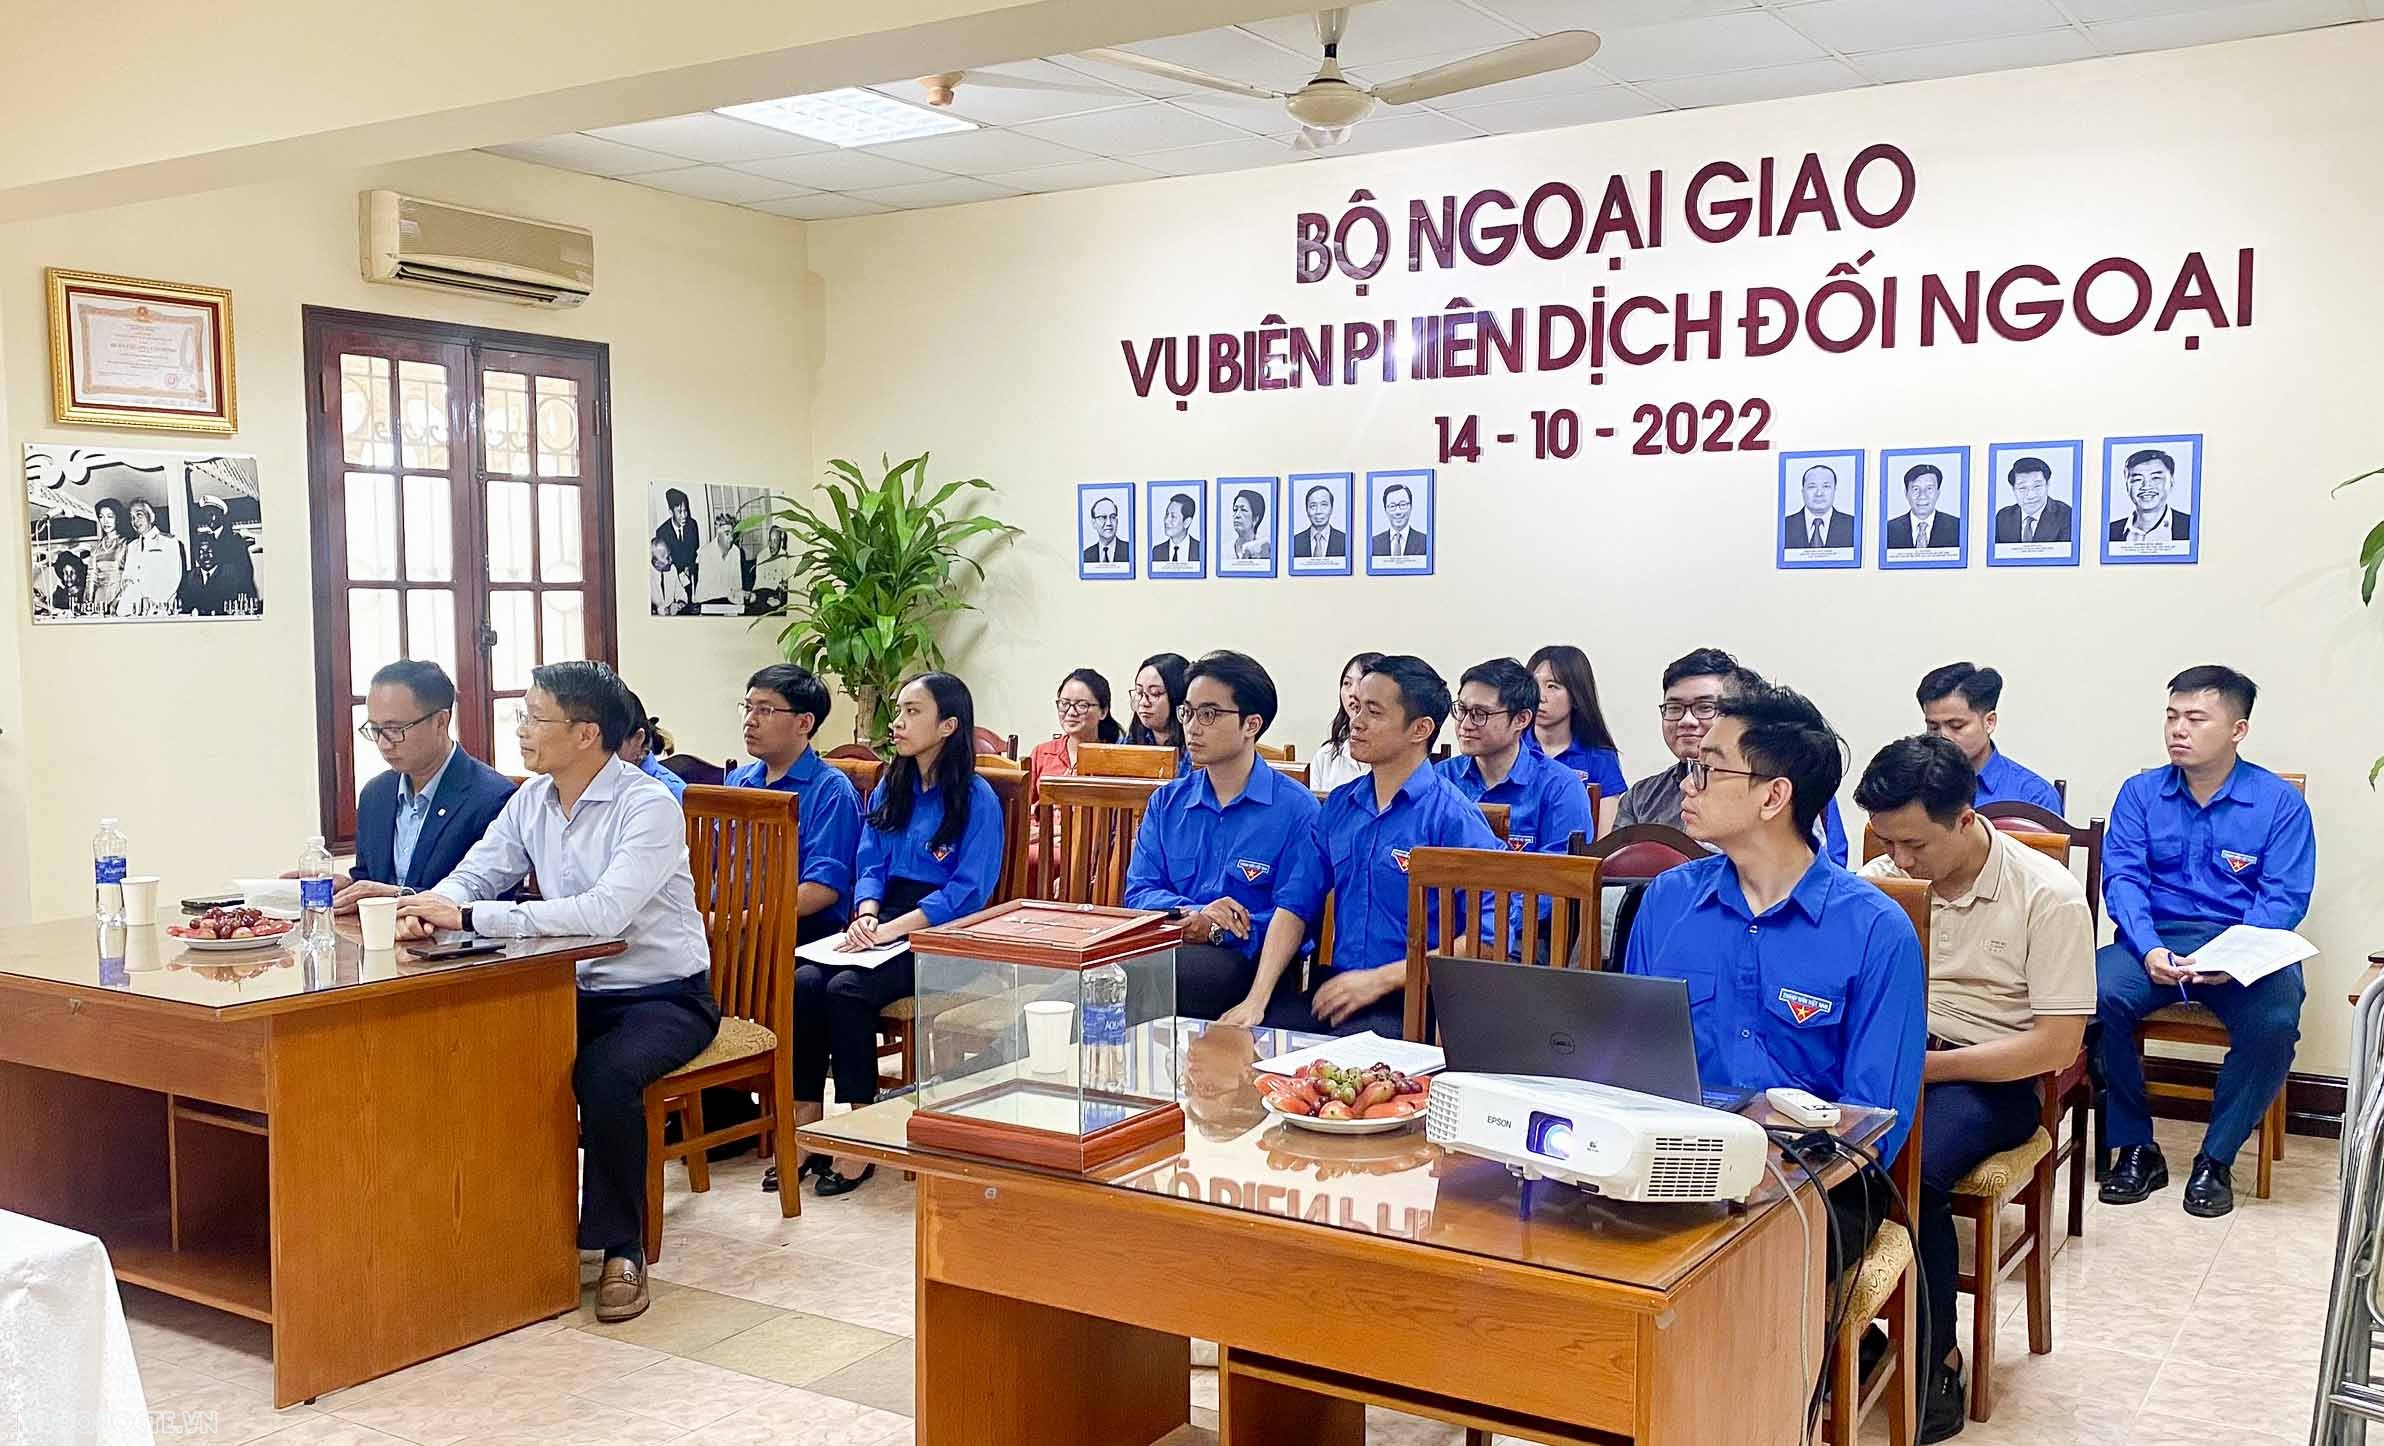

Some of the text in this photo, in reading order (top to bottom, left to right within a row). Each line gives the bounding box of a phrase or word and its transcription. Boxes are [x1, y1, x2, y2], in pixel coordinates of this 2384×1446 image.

[1297, 144, 1916, 297] BỘ NGOẠI GIAO
[1121, 336, 1200, 411] VỤ
[1209, 314, 1334, 393] BIÊN
[1538, 286, 1723, 386] DỊCH
[1738, 250, 1898, 358] ĐỐI
[1920, 248, 2254, 351] NGOẠI
[1435, 415, 1481, 463] 14
[1531, 409, 1579, 460] 10
[1633, 398, 1771, 456] 2022
[1487, 1115, 1512, 1129] EPSON
